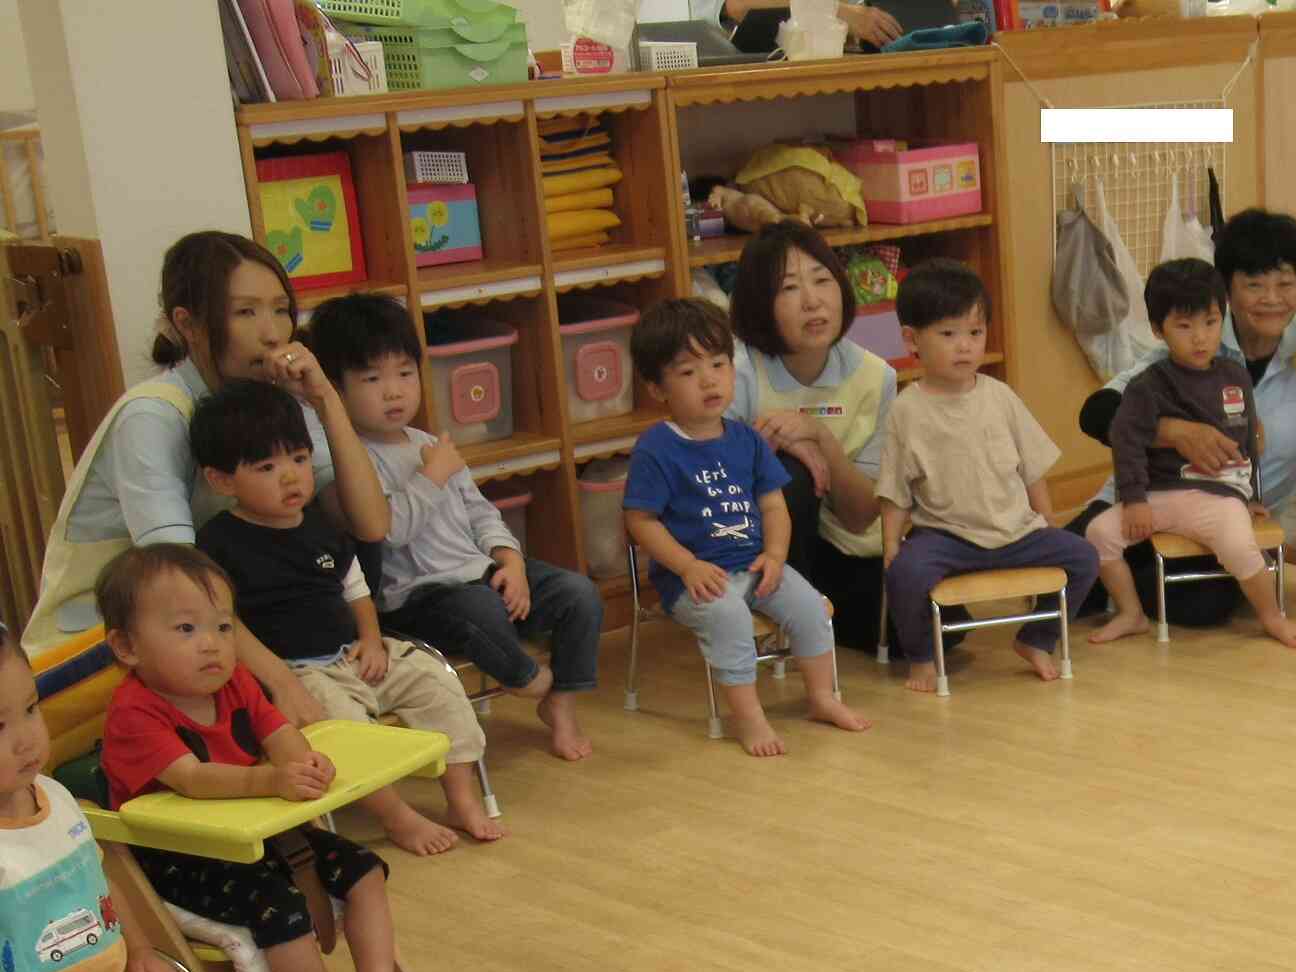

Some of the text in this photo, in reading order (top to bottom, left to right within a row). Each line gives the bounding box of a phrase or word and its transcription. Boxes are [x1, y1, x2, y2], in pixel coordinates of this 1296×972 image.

[695, 461, 728, 484] LET'S
[701, 500, 751, 518] A TRIP
